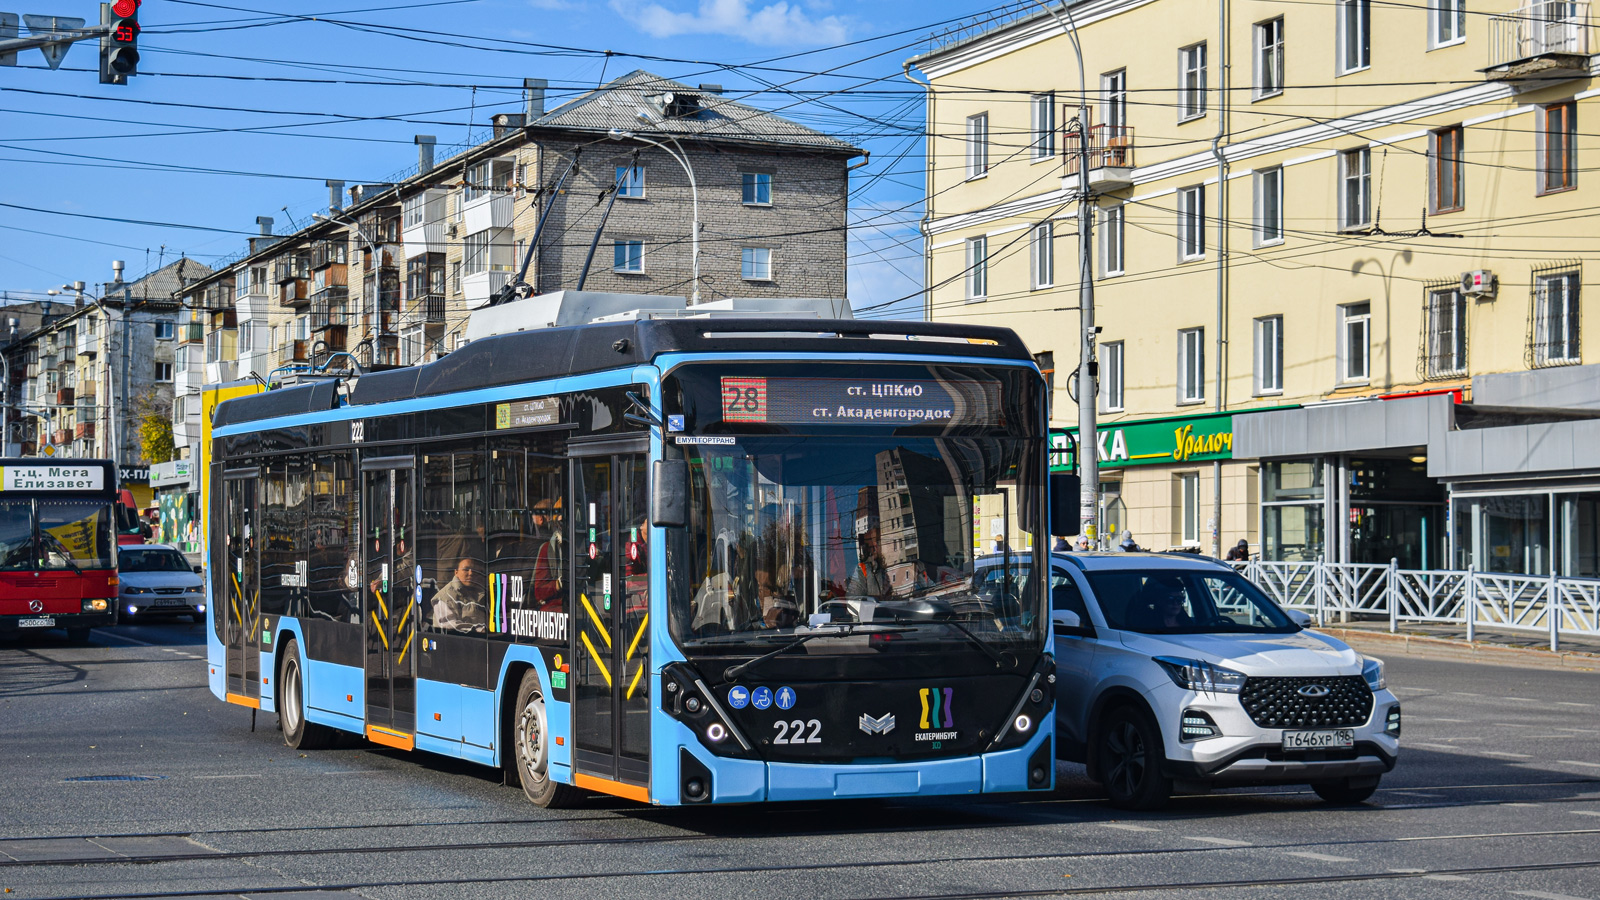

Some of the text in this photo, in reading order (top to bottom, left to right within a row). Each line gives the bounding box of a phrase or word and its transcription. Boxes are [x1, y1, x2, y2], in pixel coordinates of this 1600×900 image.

[117, 26, 132, 41] 53
[847, 384, 923, 397] ст. ЦПКиО
[728, 387, 759, 412] 28
[812, 406, 951, 420] ст. Академгородок
[352, 421, 364, 440] 222
[13, 468, 89, 478] т.ц. Мега
[14, 479, 93, 488] Елизавет
[511, 608, 569, 641] ЕКАТЕРИНБУРГ
[773, 719, 822, 744] 222
[914, 731, 958, 741] ЕКАТЕРИНБУРГ
